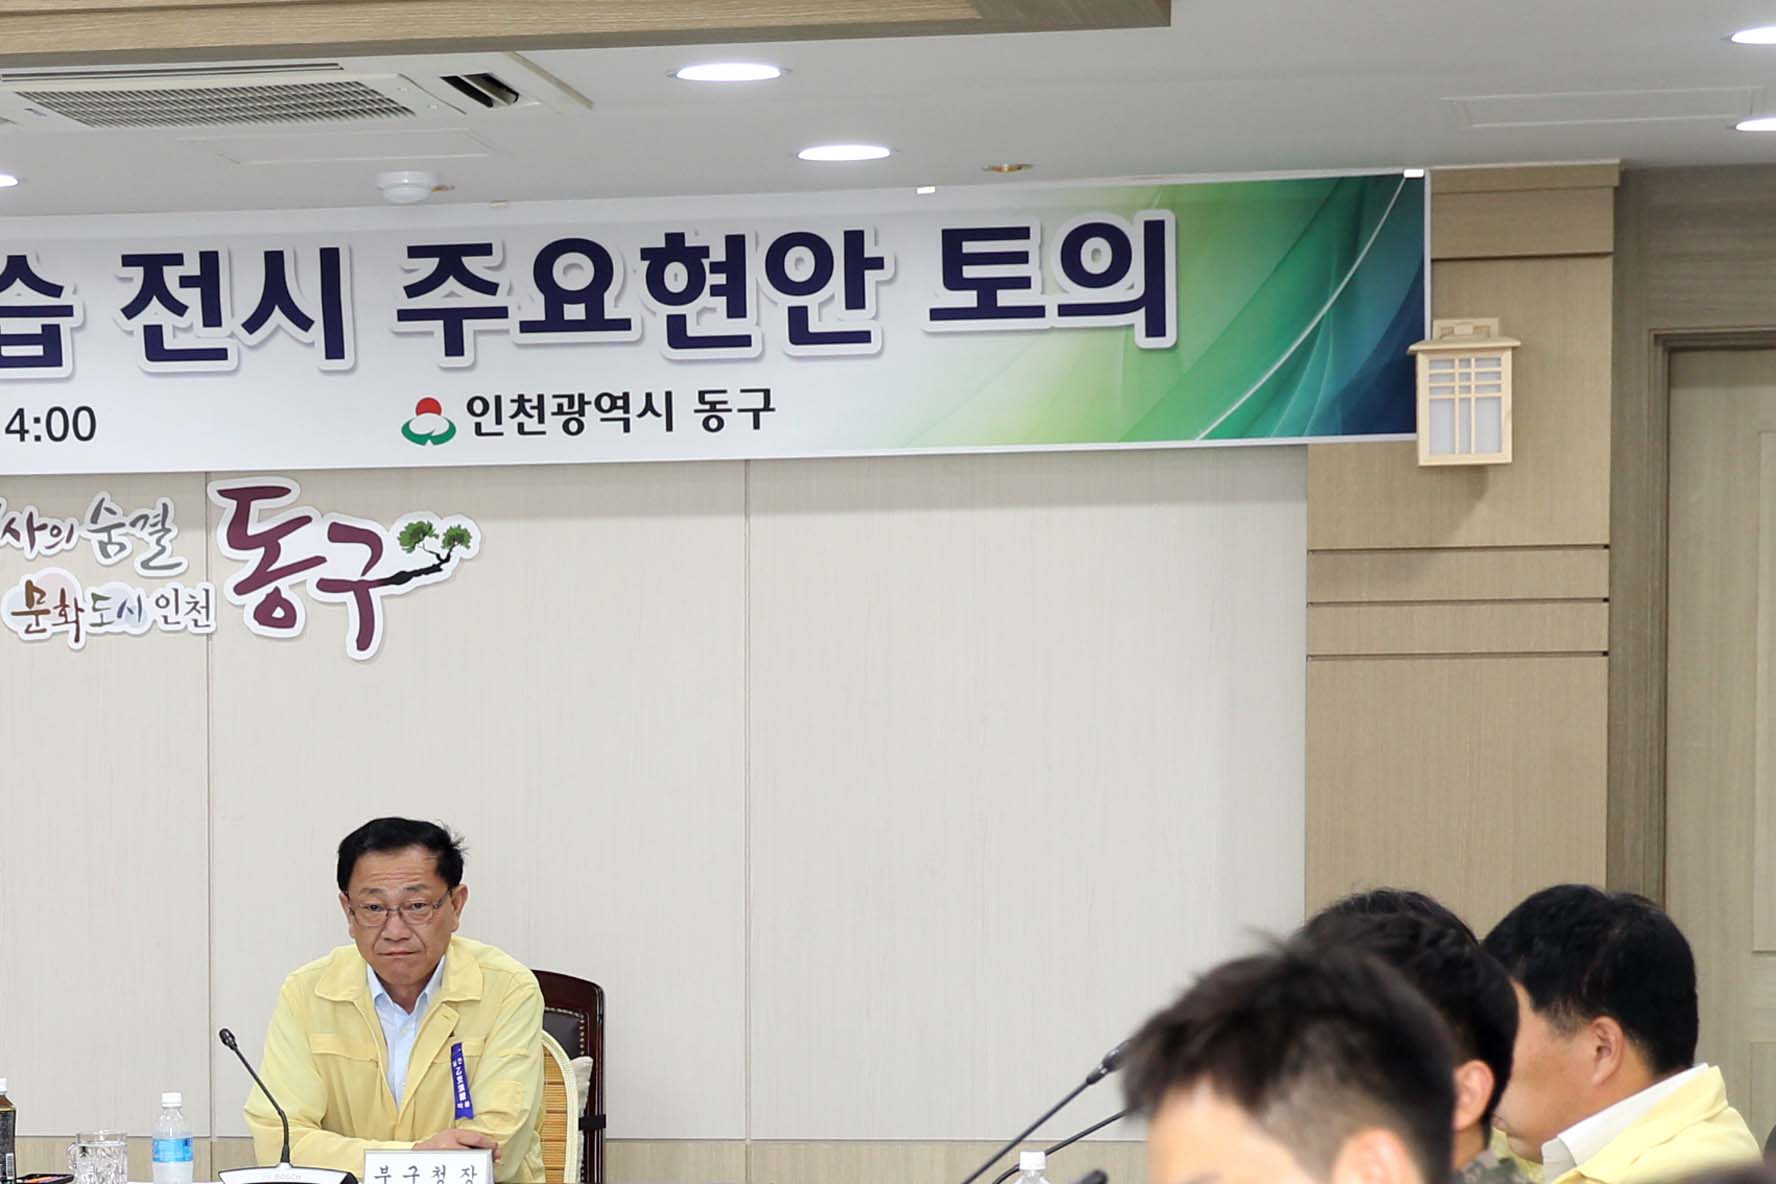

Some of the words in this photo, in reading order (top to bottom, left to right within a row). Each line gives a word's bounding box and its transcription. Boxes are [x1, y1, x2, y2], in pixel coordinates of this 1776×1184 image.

[121, 246, 345, 363] 전시
[396, 229, 885, 358] 주요현안
[930, 217, 1180, 339] 토의
[466, 390, 673, 437] 인천광역시
[693, 388, 776, 433] 동구
[87, 497, 182, 570] 숨결
[217, 485, 390, 652] 동구
[10, 579, 144, 644] 문화도시
[154, 588, 212, 628] 인천
